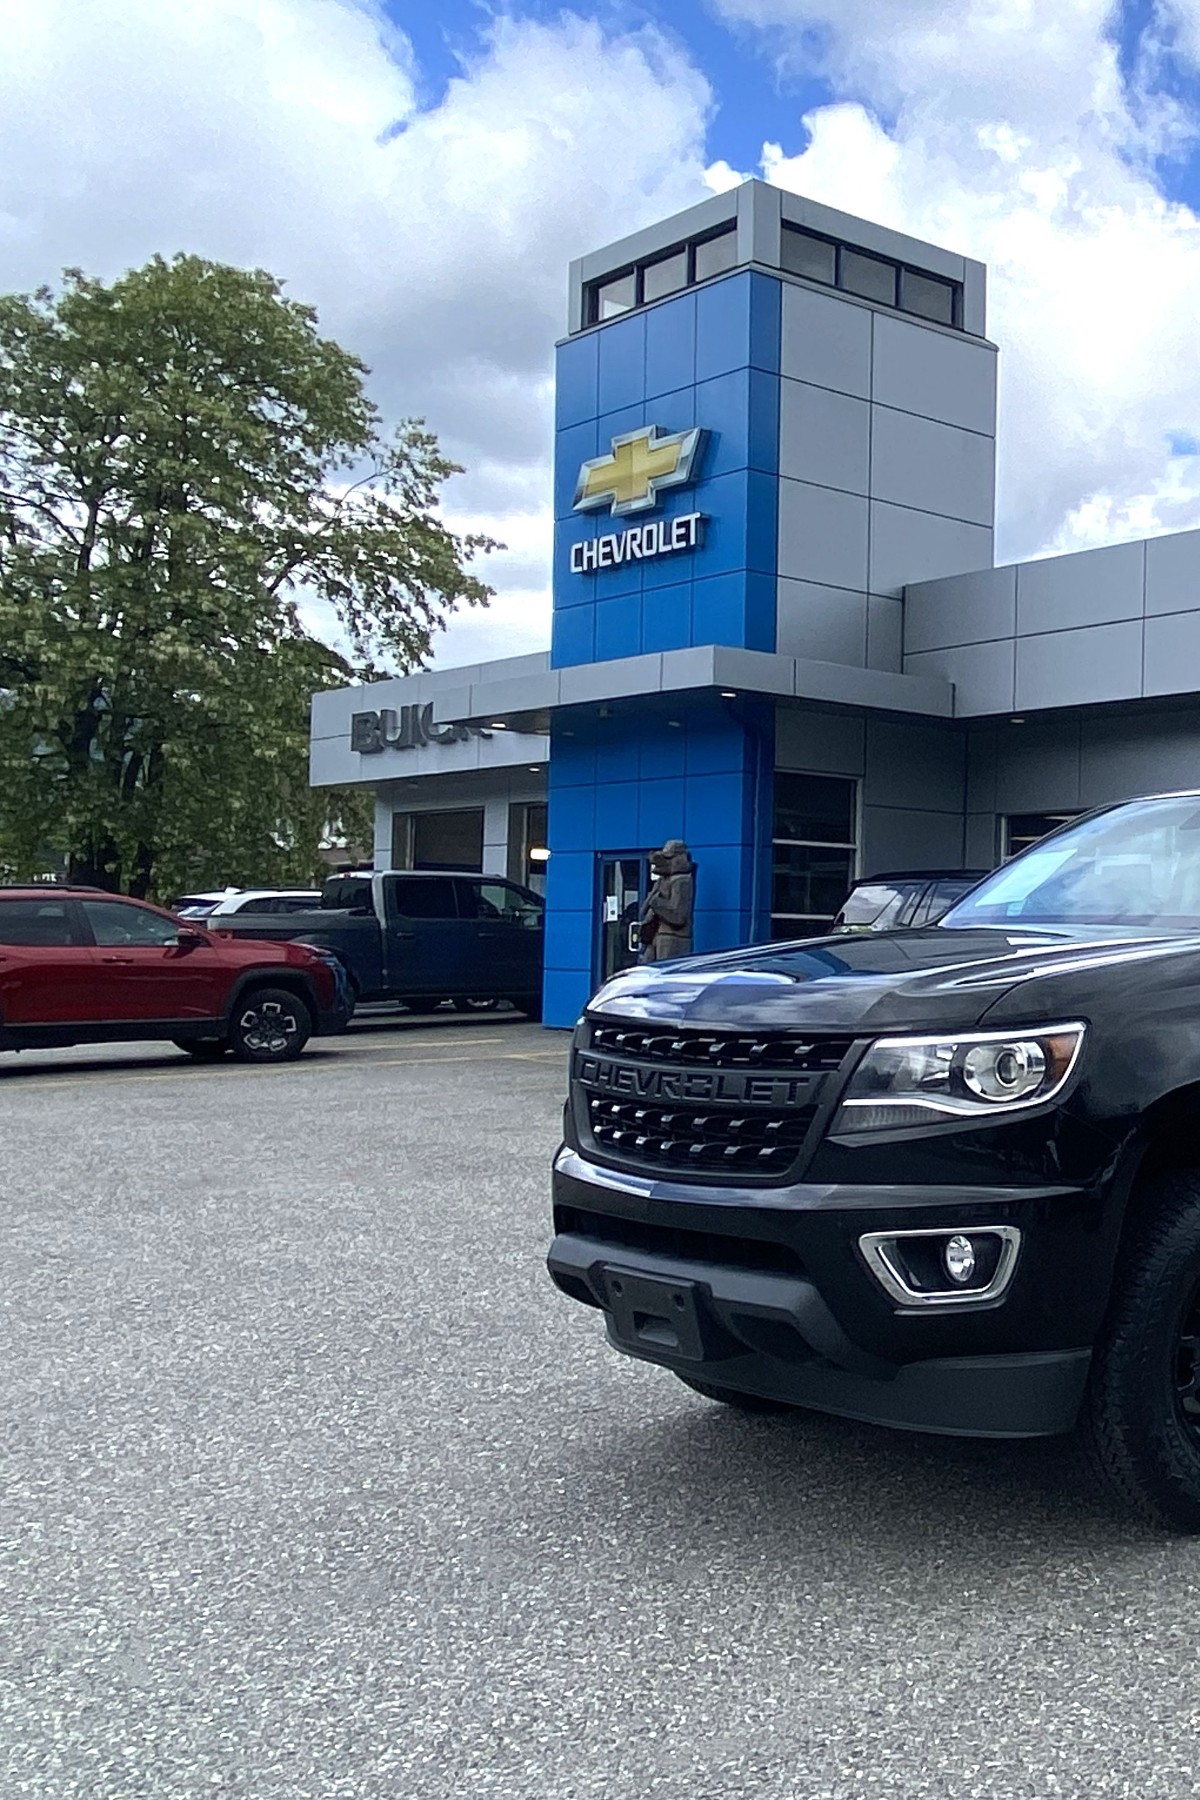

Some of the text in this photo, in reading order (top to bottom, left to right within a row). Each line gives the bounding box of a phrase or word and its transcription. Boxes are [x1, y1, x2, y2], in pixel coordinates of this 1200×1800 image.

[570, 512, 703, 574] CHEVROLET
[350, 701, 492, 755] BUIC
[578, 1056, 810, 1105] CHEVROLET
